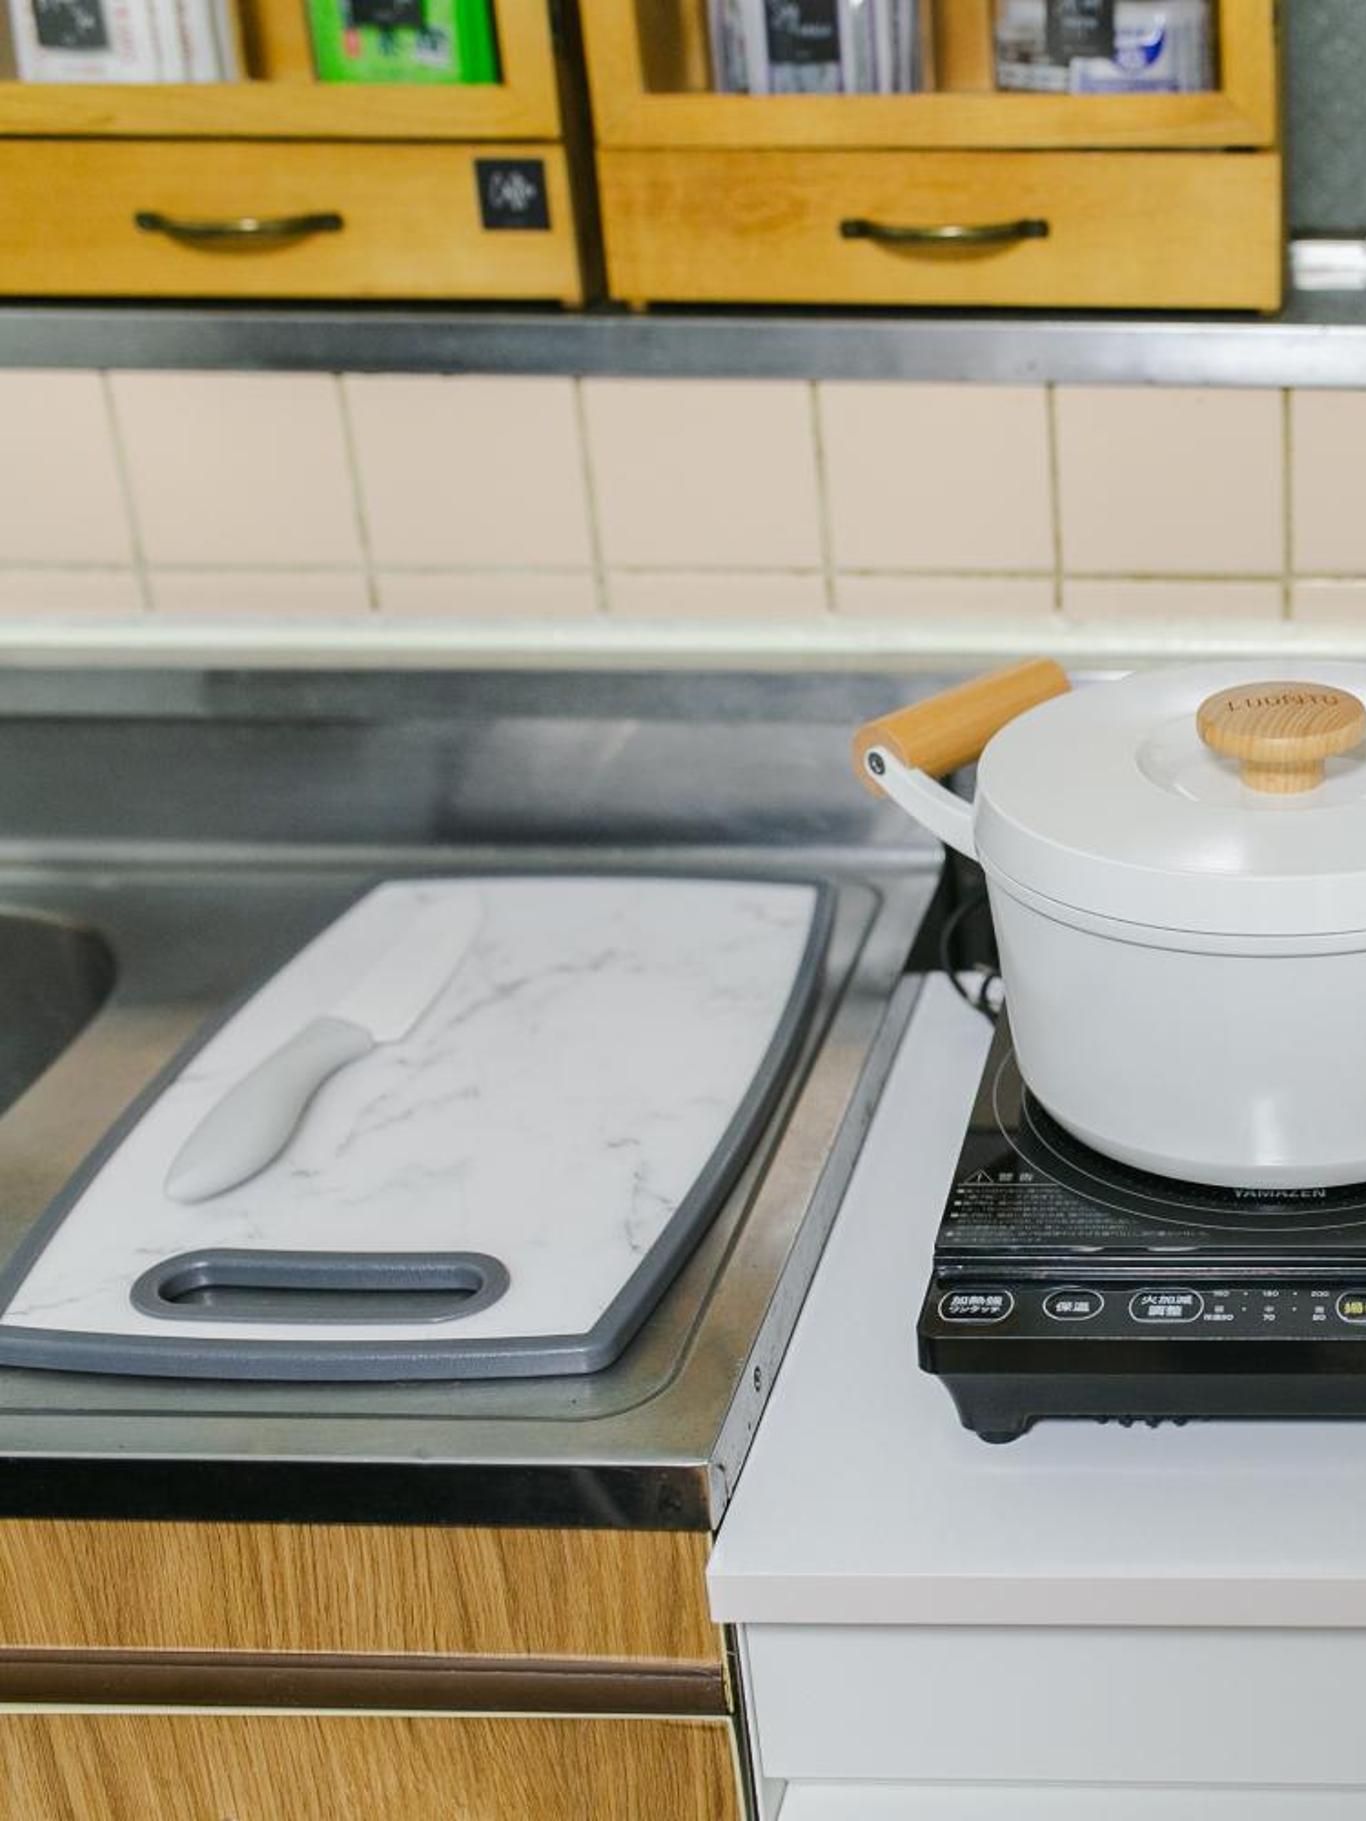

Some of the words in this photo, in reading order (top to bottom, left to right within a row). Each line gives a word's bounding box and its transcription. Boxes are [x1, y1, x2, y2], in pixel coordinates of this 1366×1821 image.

[1233, 1187, 1327, 1198] YAMAZEN
[1141, 1295, 1192, 1305] 火加減
